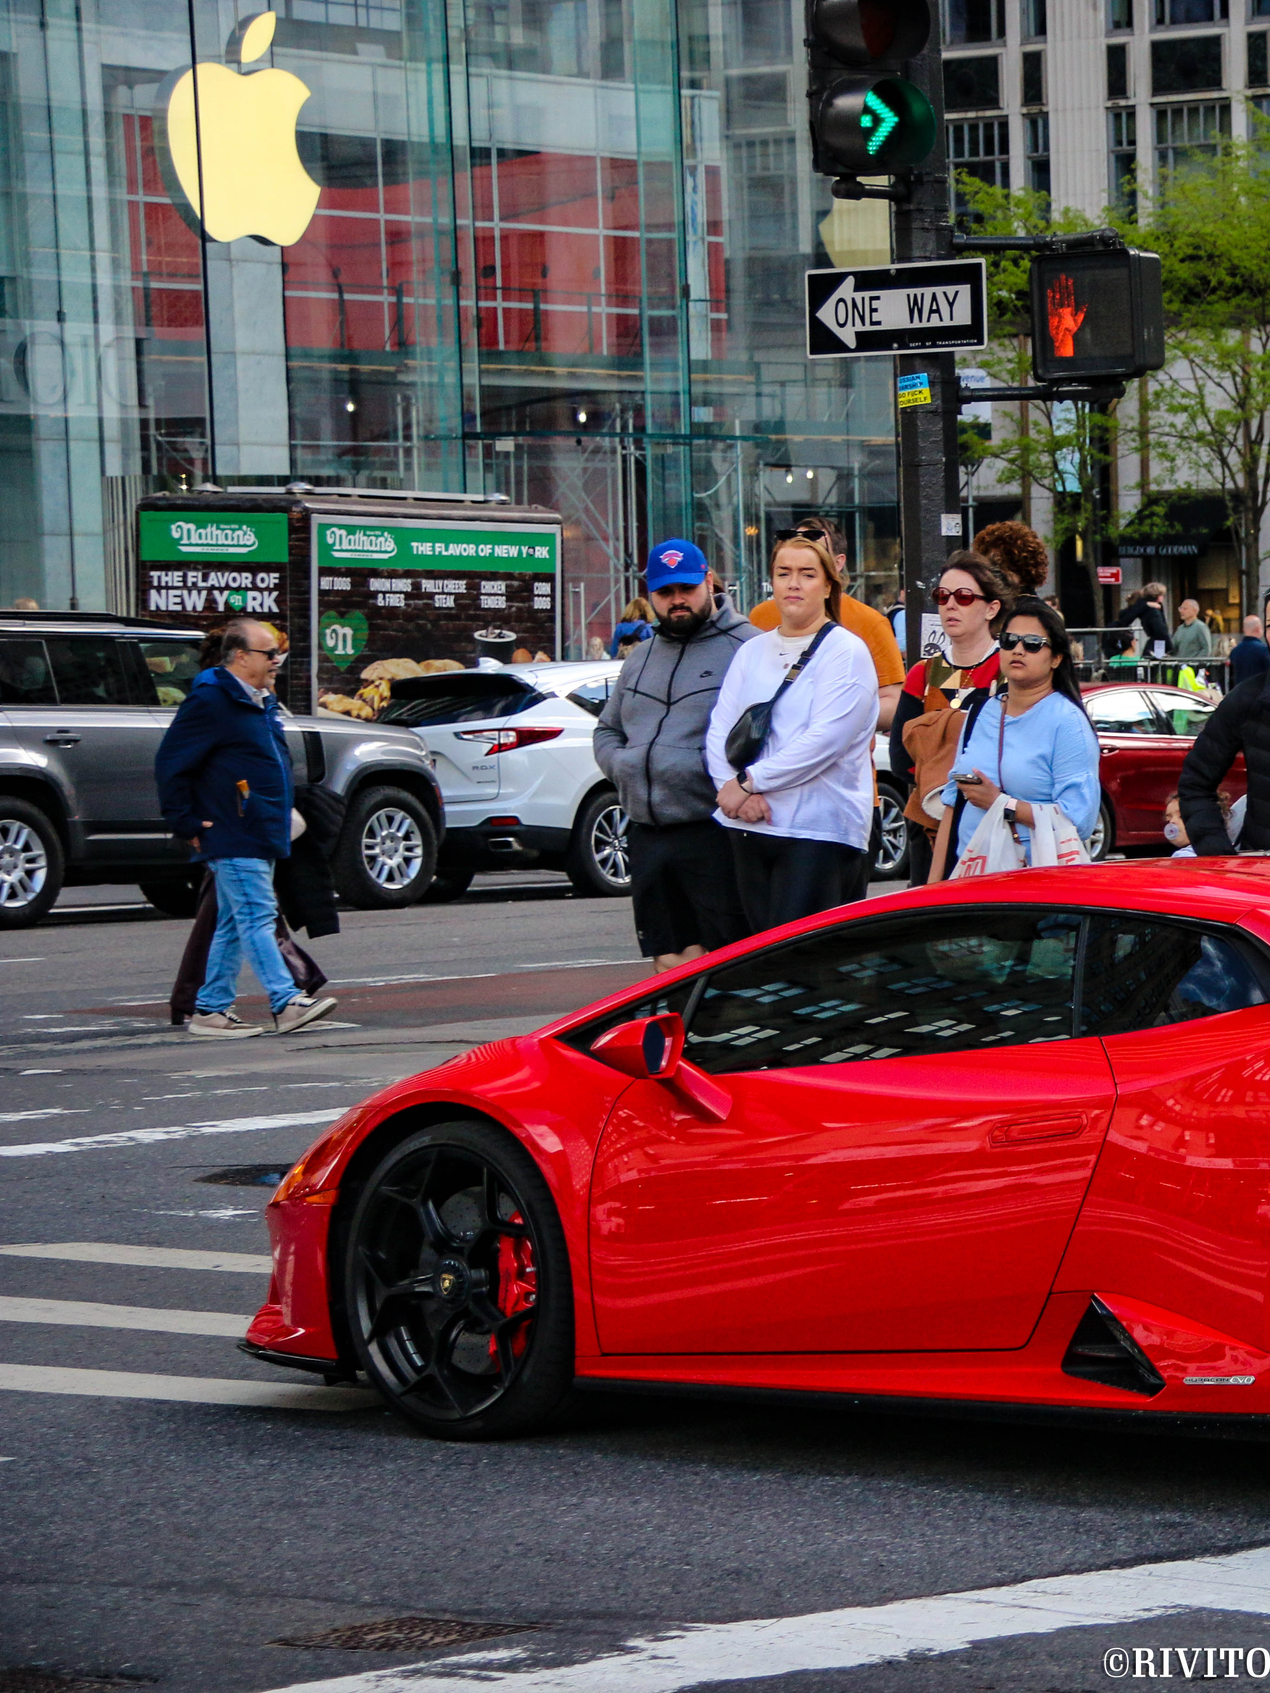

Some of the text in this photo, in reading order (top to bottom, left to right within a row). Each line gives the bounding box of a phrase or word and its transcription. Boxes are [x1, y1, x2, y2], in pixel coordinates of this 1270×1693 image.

[835, 290, 960, 328] ONE WAY
[899, 397, 927, 406] OURSELF
[411, 542, 433, 555] THE
[435, 543, 476, 556] FLAVOR
[478, 545, 493, 557] OF
[494, 545, 519, 557] NEW
[150, 570, 280, 588] THE FLAVOR OF
[149, 589, 208, 612] NEW
[434, 594, 455, 607] STEAK
